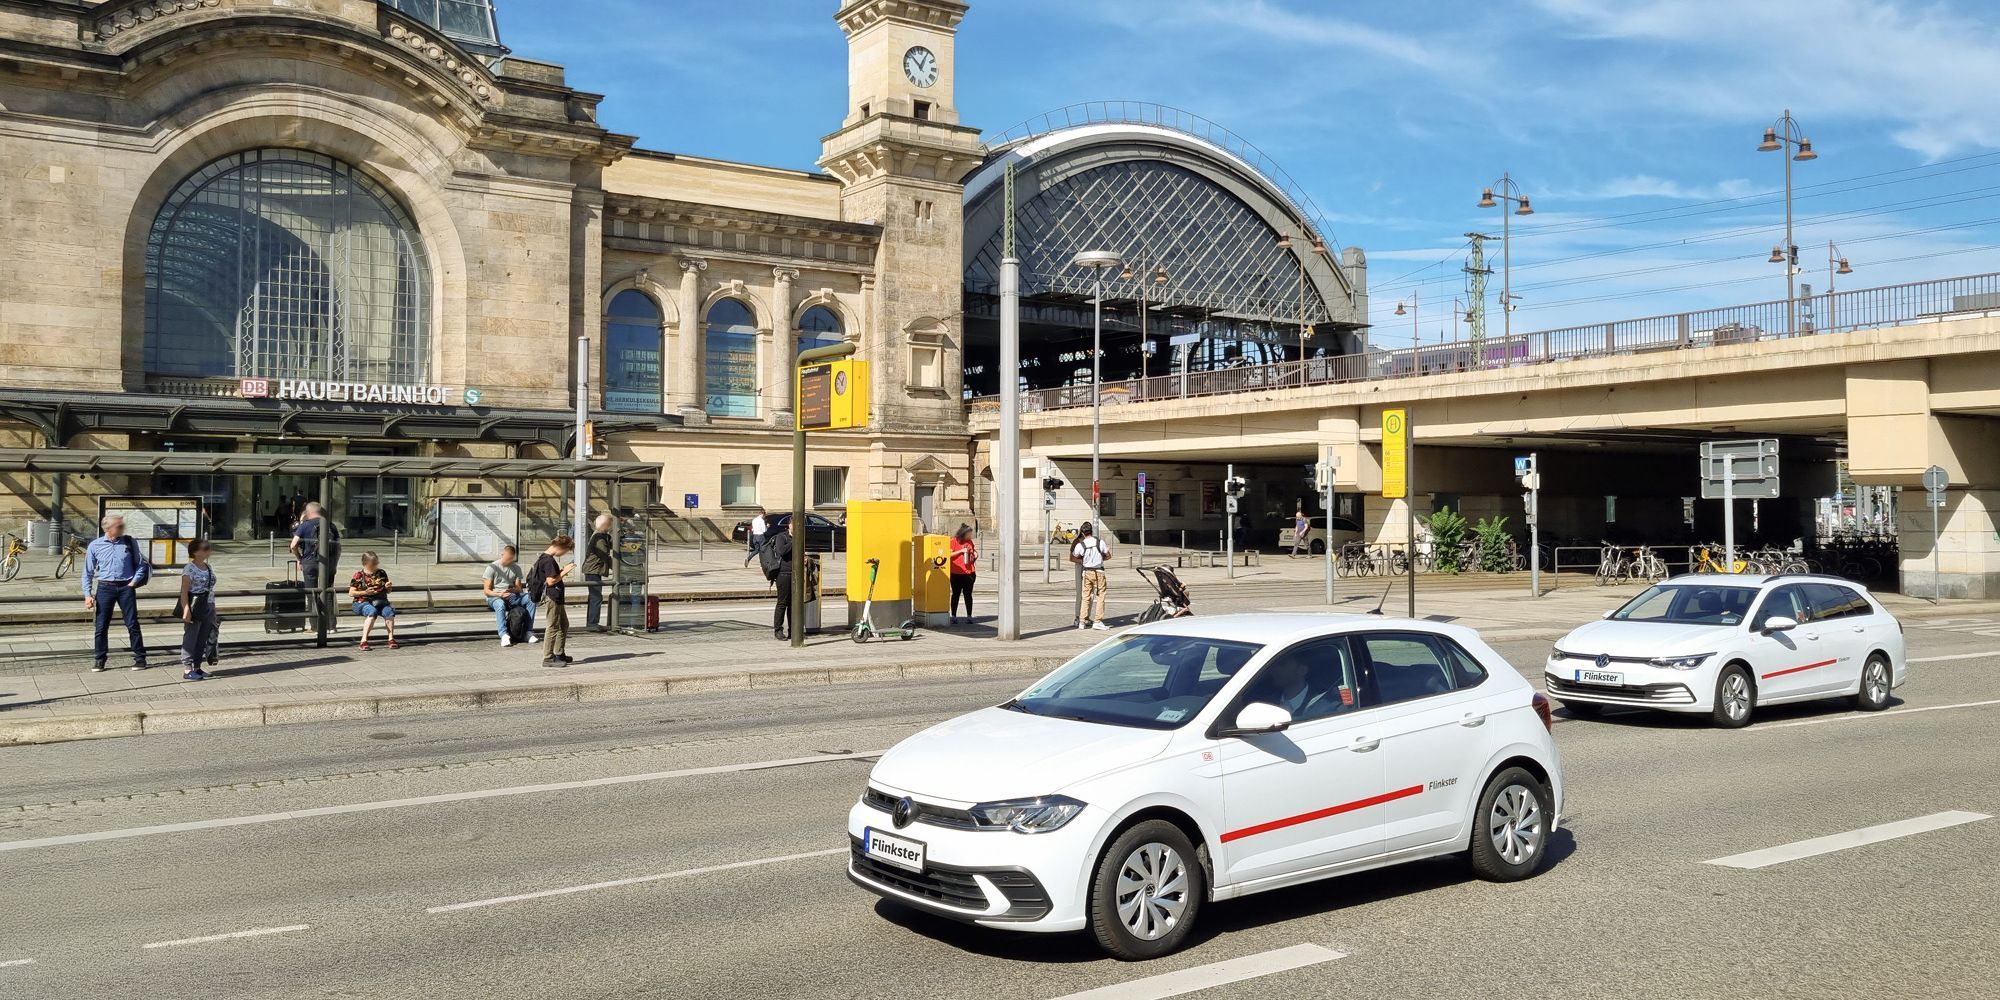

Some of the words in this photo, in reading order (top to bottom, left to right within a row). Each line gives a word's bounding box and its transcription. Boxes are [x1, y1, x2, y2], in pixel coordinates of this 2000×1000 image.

[1150, 341, 1156, 352] E
[244, 381, 265, 394] DB
[280, 380, 453, 404] HAUPTBAHNHOF
[466, 389, 479, 404] S
[1515, 459, 1526, 470] W
[1584, 672, 1618, 682] Flinkster
[1429, 777, 1458, 791] Flinkster
[872, 838, 920, 862] Flinkster
